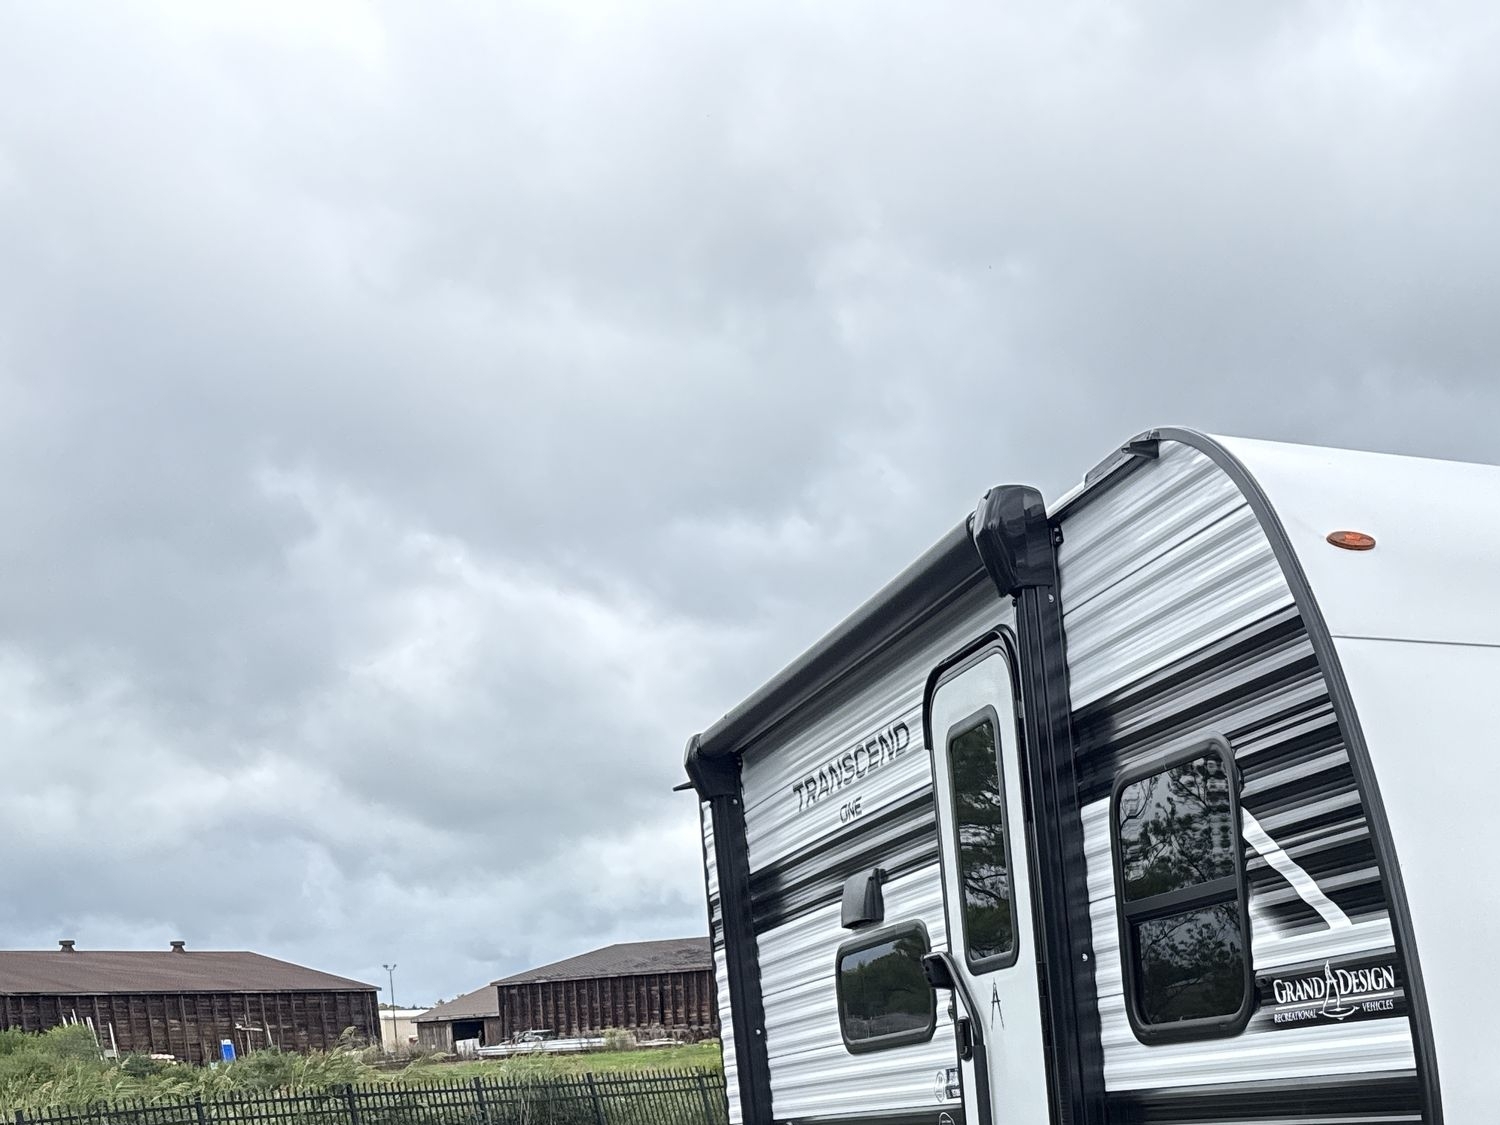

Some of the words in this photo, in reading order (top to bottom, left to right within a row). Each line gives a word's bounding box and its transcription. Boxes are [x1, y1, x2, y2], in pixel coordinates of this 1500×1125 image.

[793, 721, 910, 812] TRANSCEND
[840, 796, 862, 823] ONE
[1273, 978, 1325, 1003] GRAND
[1335, 965, 1395, 994] DESIGN
[1274, 1008, 1317, 1023] RECREATIONAL
[1362, 999, 1394, 1012] VEHICLES
